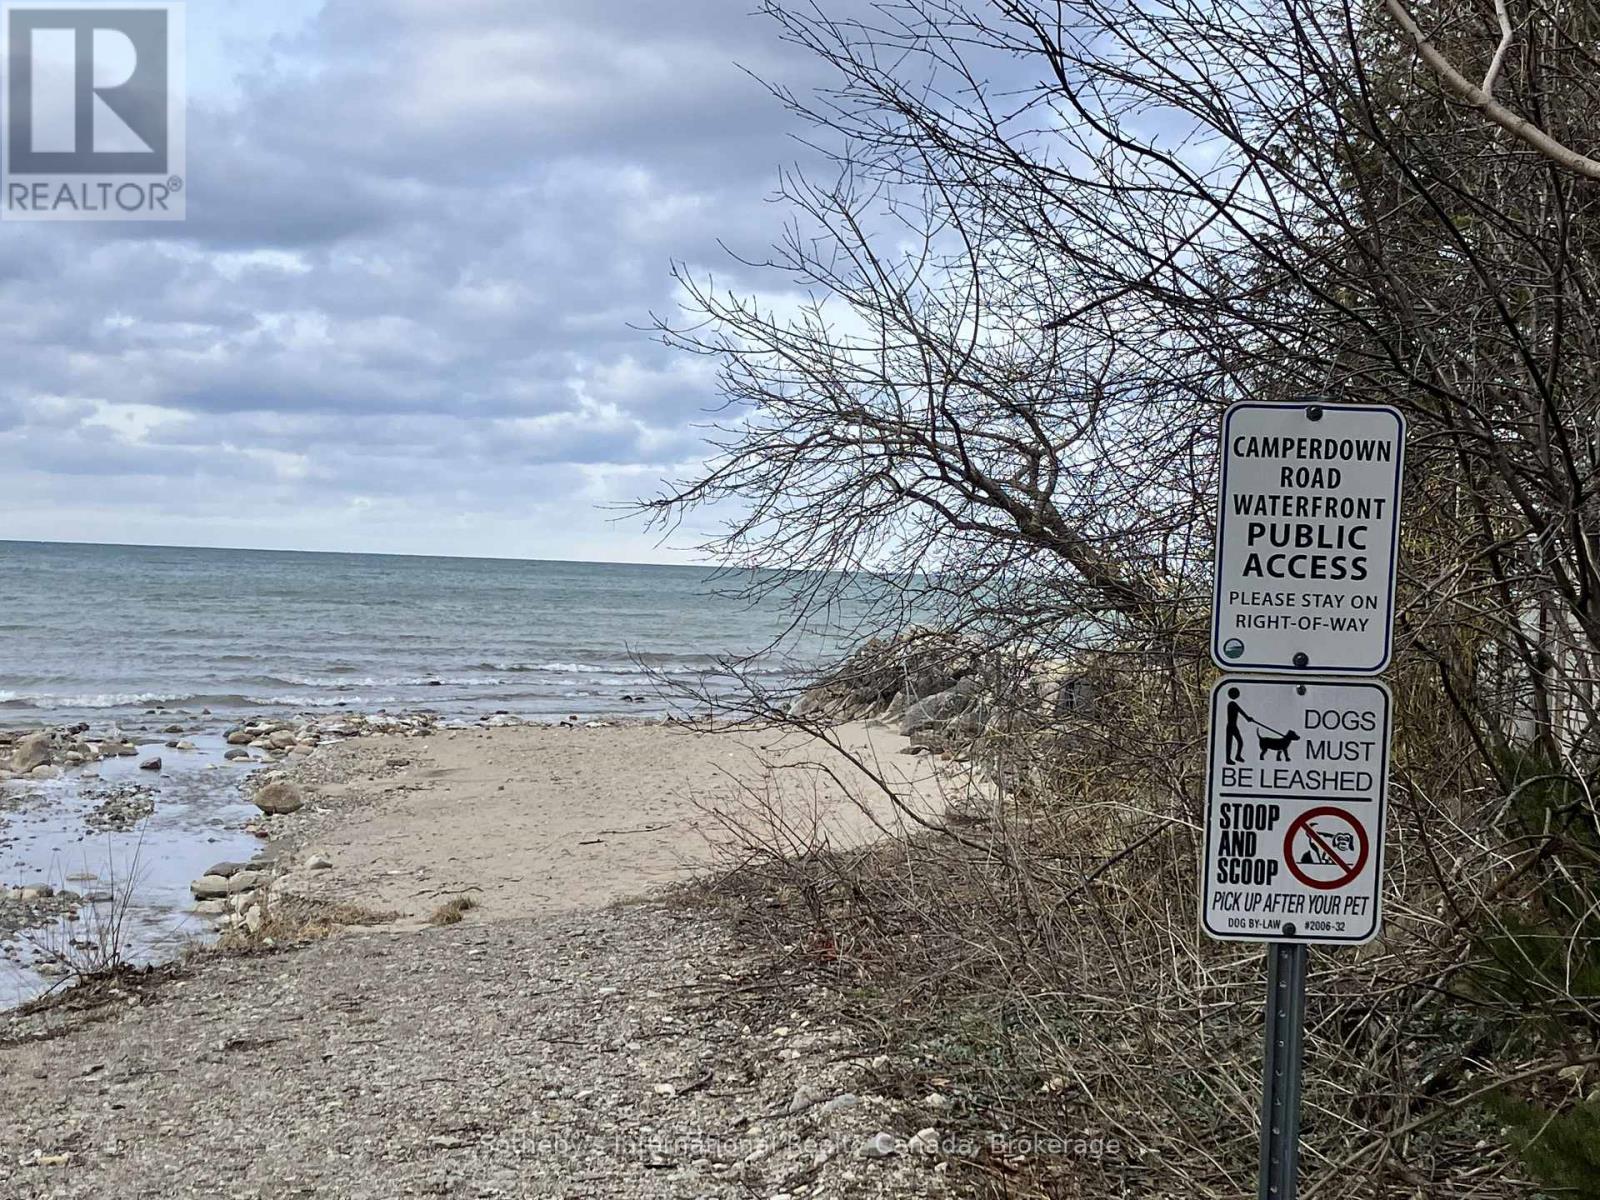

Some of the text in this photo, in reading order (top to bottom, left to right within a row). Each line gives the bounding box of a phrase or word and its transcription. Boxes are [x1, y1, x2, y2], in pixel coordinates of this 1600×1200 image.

[1233, 436, 1392, 462] CAMPERDOWN
[1280, 466, 1341, 489] ROAD
[1233, 494, 1386, 520] WATERFRONT
[1247, 522, 1368, 550] PUBLIC
[1242, 553, 1368, 581] ACCESS
[1229, 591, 1378, 610] PLEASE STAY ON
[1235, 614, 1369, 632] RIGHT-OF-WAY
[1304, 709, 1377, 732] DOGS
[1305, 740, 1376, 762] MUST
[1221, 767, 1373, 792] BE LEASHED
[1219, 803, 1280, 831] STOOP
[1218, 831, 1257, 857] AND
[1217, 858, 1279, 886] SCOOP
[1212, 891, 1370, 916] PICK UP AFTER YOUR PET
[1228, 917, 1346, 932] DOG BY-LAW #2006-32
